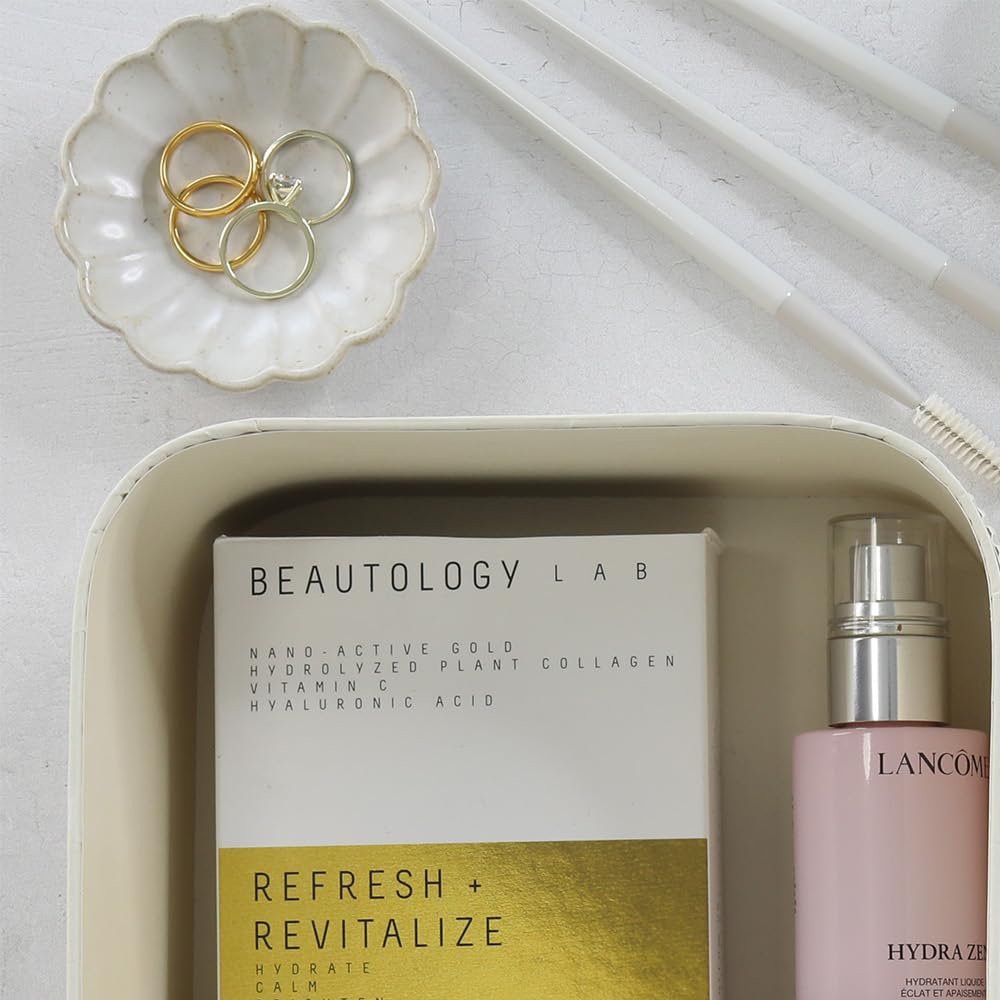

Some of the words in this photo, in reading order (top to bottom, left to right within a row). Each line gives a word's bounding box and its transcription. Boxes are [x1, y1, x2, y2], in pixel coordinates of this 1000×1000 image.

[252, 560, 519, 595] BEAUTOLOGY
[250, 643, 428, 658] NANO-ACTIVE
[452, 641, 511, 654] GOLD
[251, 661, 416, 676] HYDROLYZED
[441, 659, 518, 671] PLANT
[543, 656, 673, 669] COLLAGEN
[251, 681, 355, 694] VITAMIN
[380, 680, 386, 691] C
[251, 697, 411, 711] HYALURONIC
[436, 695, 492, 707] ACID
[255, 869, 441, 901] REFRESH
[255, 917, 502, 950] REVITALIZE
[888, 944, 963, 960] HYDRA
[256, 962, 369, 975] HYDRATE
[256, 981, 316, 993] CALM
[906, 978, 958, 986] HYDRATANT
[901, 989, 930, 997] ÉCLAT
[933, 989, 943, 997] ET
